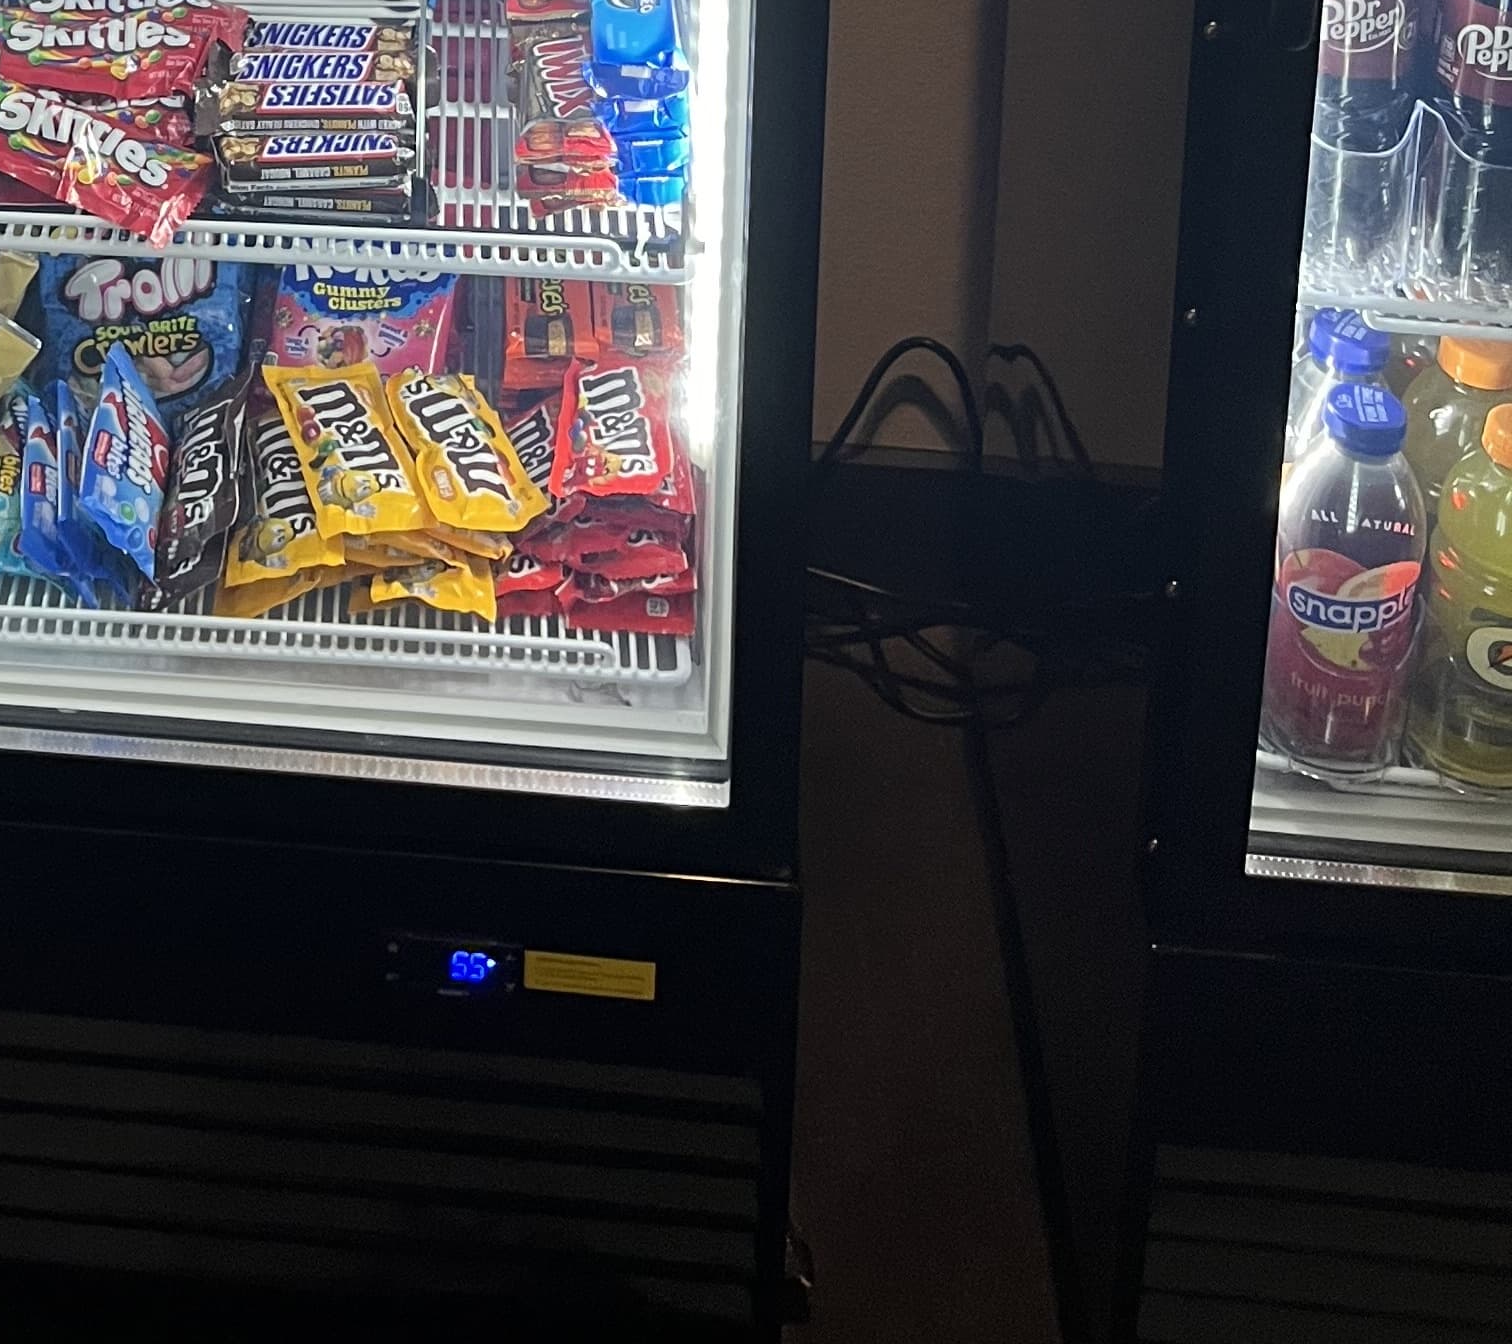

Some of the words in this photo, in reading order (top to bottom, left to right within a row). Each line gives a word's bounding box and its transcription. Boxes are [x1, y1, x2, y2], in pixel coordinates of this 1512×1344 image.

[6, 17, 190, 52] Skittles
[1320, 0, 1400, 43] Pepper
[251, 23, 372, 50] SNICKERS
[239, 54, 374, 81] SNICKERS
[534, 38, 591, 118] TWIX
[267, 84, 396, 108] SATISFIES
[265, 134, 396, 155] SNICKERS
[313, 282, 391, 299] Gummy
[328, 296, 402, 311] Clusters
[95, 322, 140, 340] SOUR
[148, 316, 197, 333] BRITE
[1290, 672, 1328, 698] fruit
